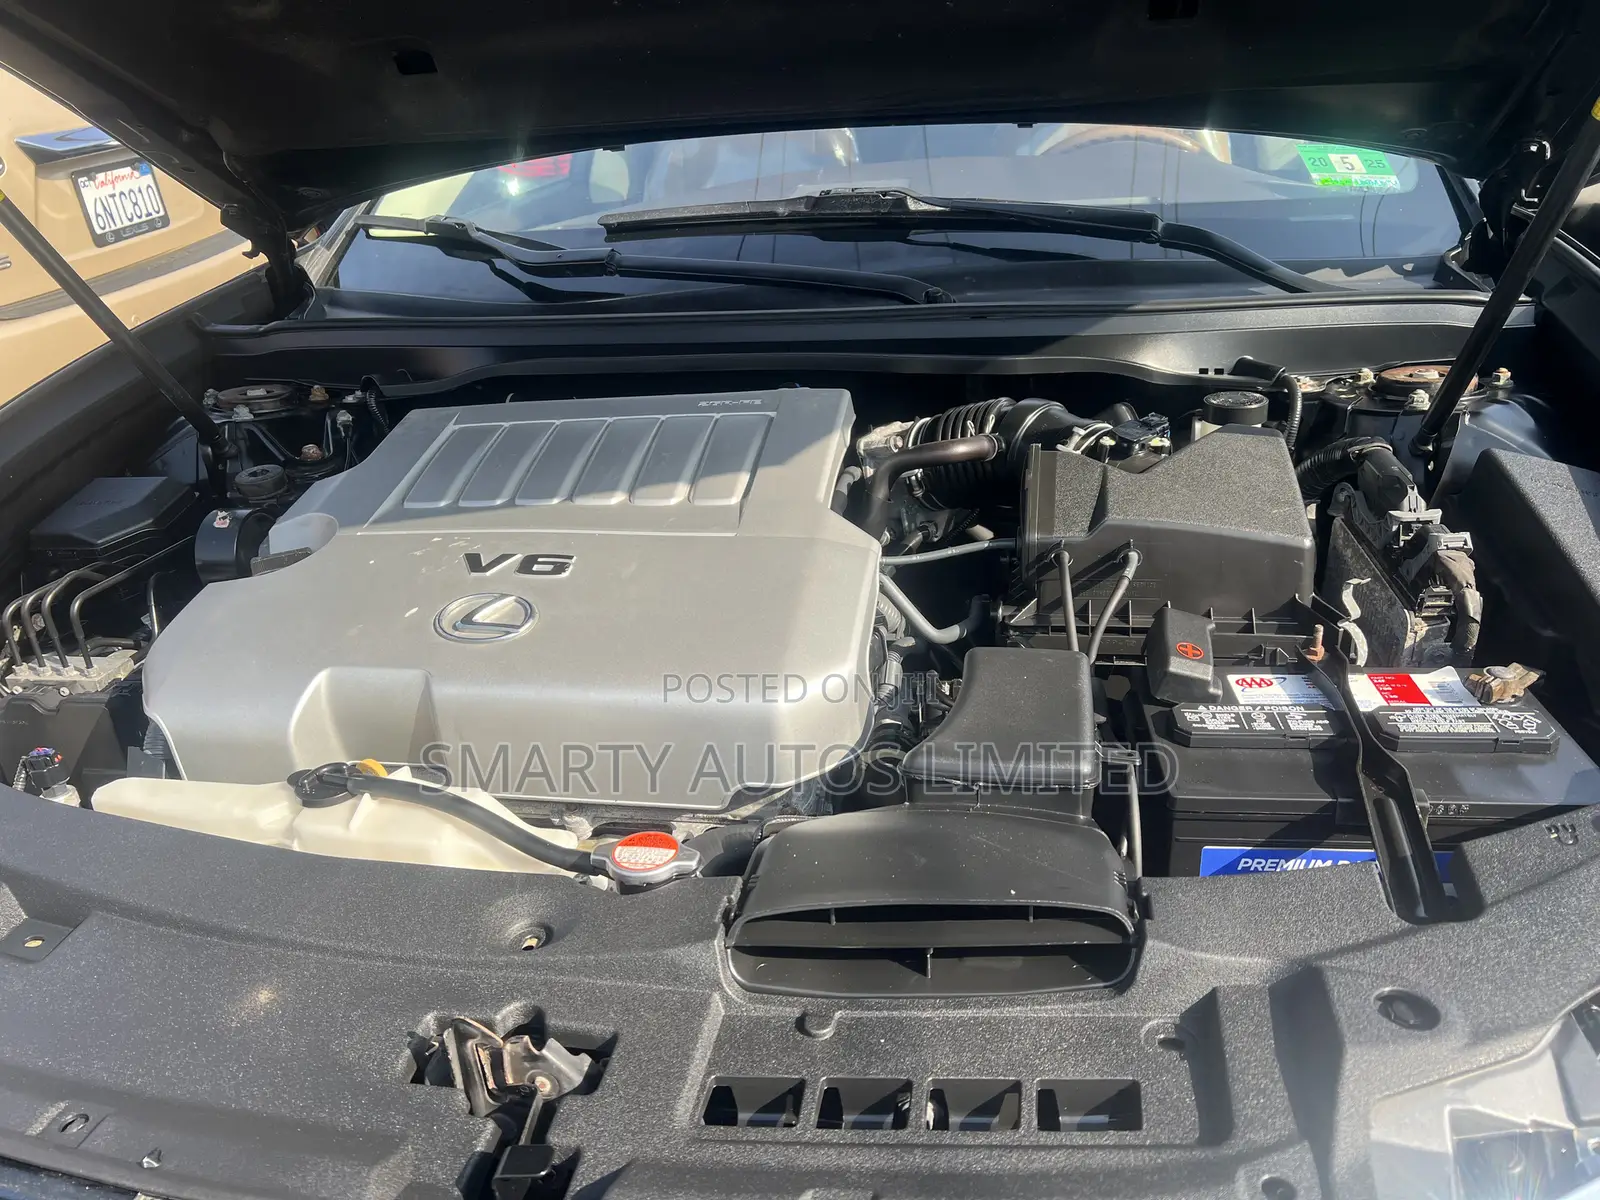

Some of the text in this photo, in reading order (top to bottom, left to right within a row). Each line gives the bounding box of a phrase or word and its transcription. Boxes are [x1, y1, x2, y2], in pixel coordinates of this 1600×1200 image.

[1308, 157, 1328, 167] 20
[1340, 156, 1355, 171] 5
[93, 171, 141, 191] California
[94, 183, 161, 231] 6NTC810
[461, 552, 577, 579] V6
[1235, 677, 1274, 689] AAA
